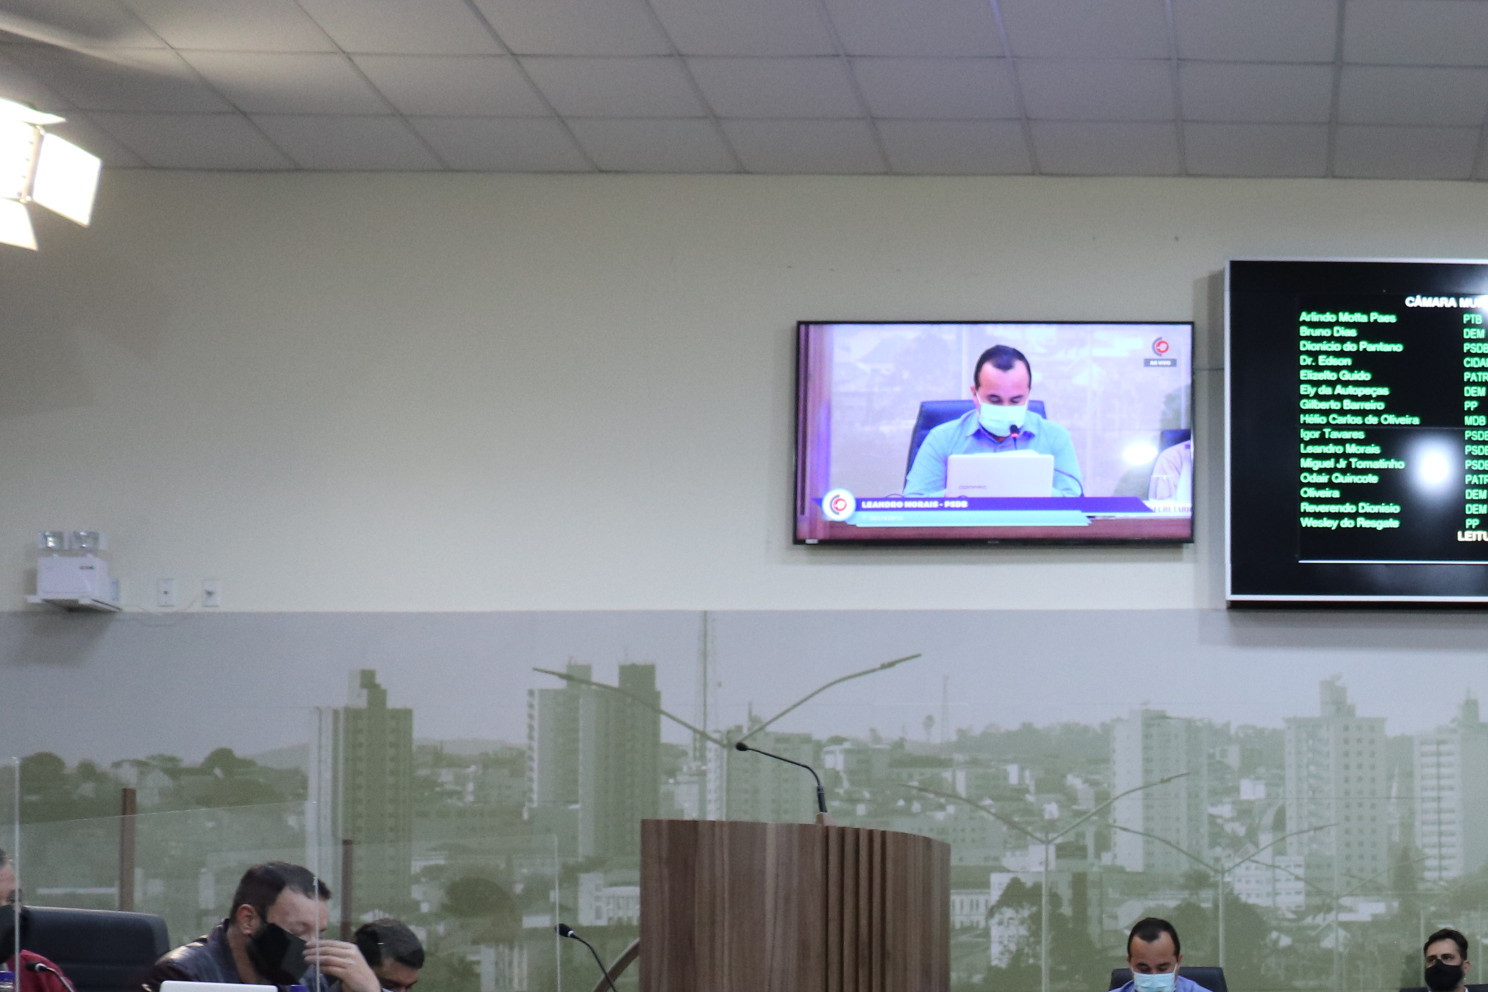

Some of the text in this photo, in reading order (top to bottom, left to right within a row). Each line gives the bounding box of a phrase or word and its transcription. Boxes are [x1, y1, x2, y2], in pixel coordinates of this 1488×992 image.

[1405, 295, 1457, 307] CÂMARA
[1299, 311, 1397, 323] Arlindo Motta Paes
[1463, 313, 1483, 324] PTB
[1299, 325, 1357, 337] Bruno Dias
[1463, 328, 1485, 339] DEM
[1343, 340, 1357, 351] do
[1359, 340, 1404, 352] Pantano
[1299, 354, 1352, 366] Dr. Edson
[1339, 369, 1372, 381] Guido
[1299, 384, 1390, 398] Ely da Autopeças
[1464, 386, 1486, 397] DEM
[1299, 398, 1385, 410] Gilberto Barreiro
[1464, 400, 1478, 411] PP
[1299, 413, 1420, 425] Hélio Carlos de Oliveira
[1464, 415, 1487, 426] MDB
[1300, 428, 1366, 441] Igor Tavares
[1300, 443, 1381, 454] Leandro Morais
[1300, 458, 1405, 470] Miguel Jr Tomatinho
[1300, 472, 1379, 484] Odair Quincote
[1300, 487, 1340, 498] Oliveira
[1465, 488, 1488, 500] DEM
[861, 500, 903, 509] LEANDRO
[904, 500, 939, 509] MORAIS
[944, 500, 968, 509] PSDB
[1300, 502, 1357, 513] Reverendo
[1465, 503, 1488, 514] DEM
[1300, 517, 1400, 530] Wesley do Resgate
[1465, 518, 1480, 529] PP
